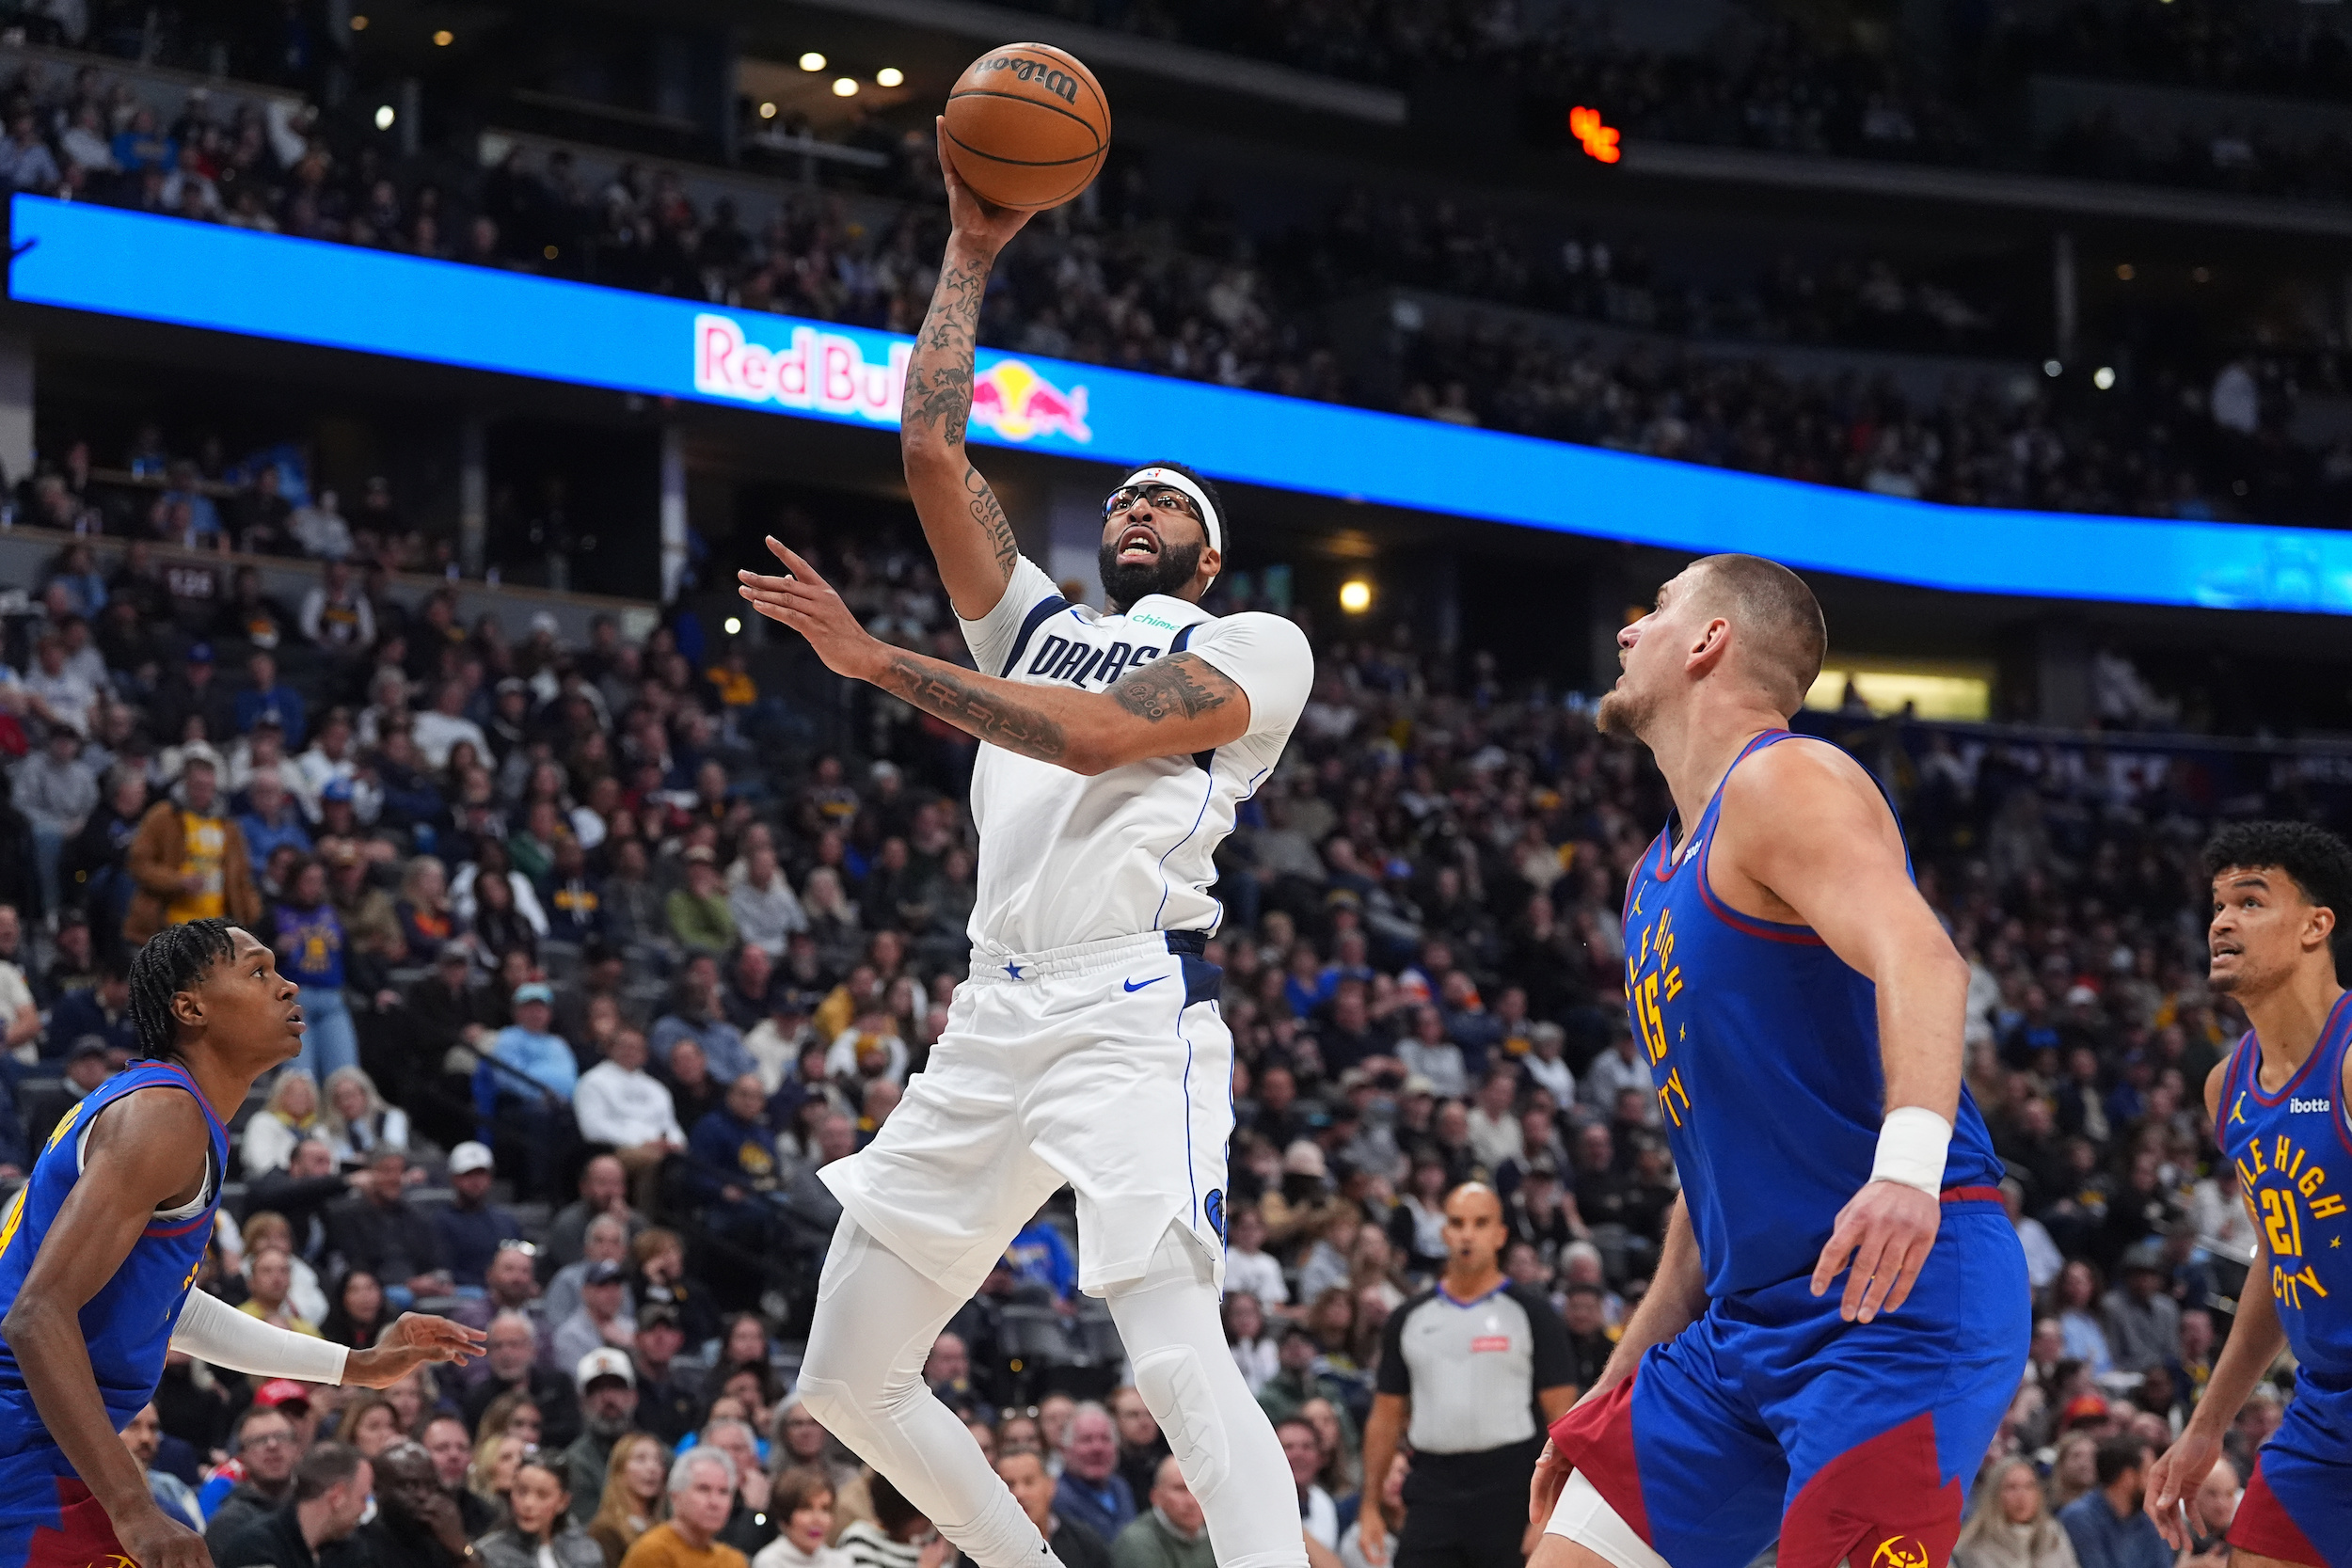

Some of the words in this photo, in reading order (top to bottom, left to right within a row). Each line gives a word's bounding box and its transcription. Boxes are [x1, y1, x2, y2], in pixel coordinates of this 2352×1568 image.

[975, 56, 1078, 105] Wilson
[700, 320, 811, 402] Red
[822, 337, 909, 415] Bul
[1132, 613, 1181, 631] chime
[1025, 634, 1162, 689] DALAS
[1653, 908, 1684, 1003] HIGH
[1634, 971, 1668, 1067] 15
[1657, 1067, 1691, 1127] ITY
[2290, 1098, 2330, 1114] ibotta
[2274, 1134, 2347, 1219] HIGH
[2260, 1188, 2302, 1257] 21
[2273, 1265, 2328, 1309] CITY
